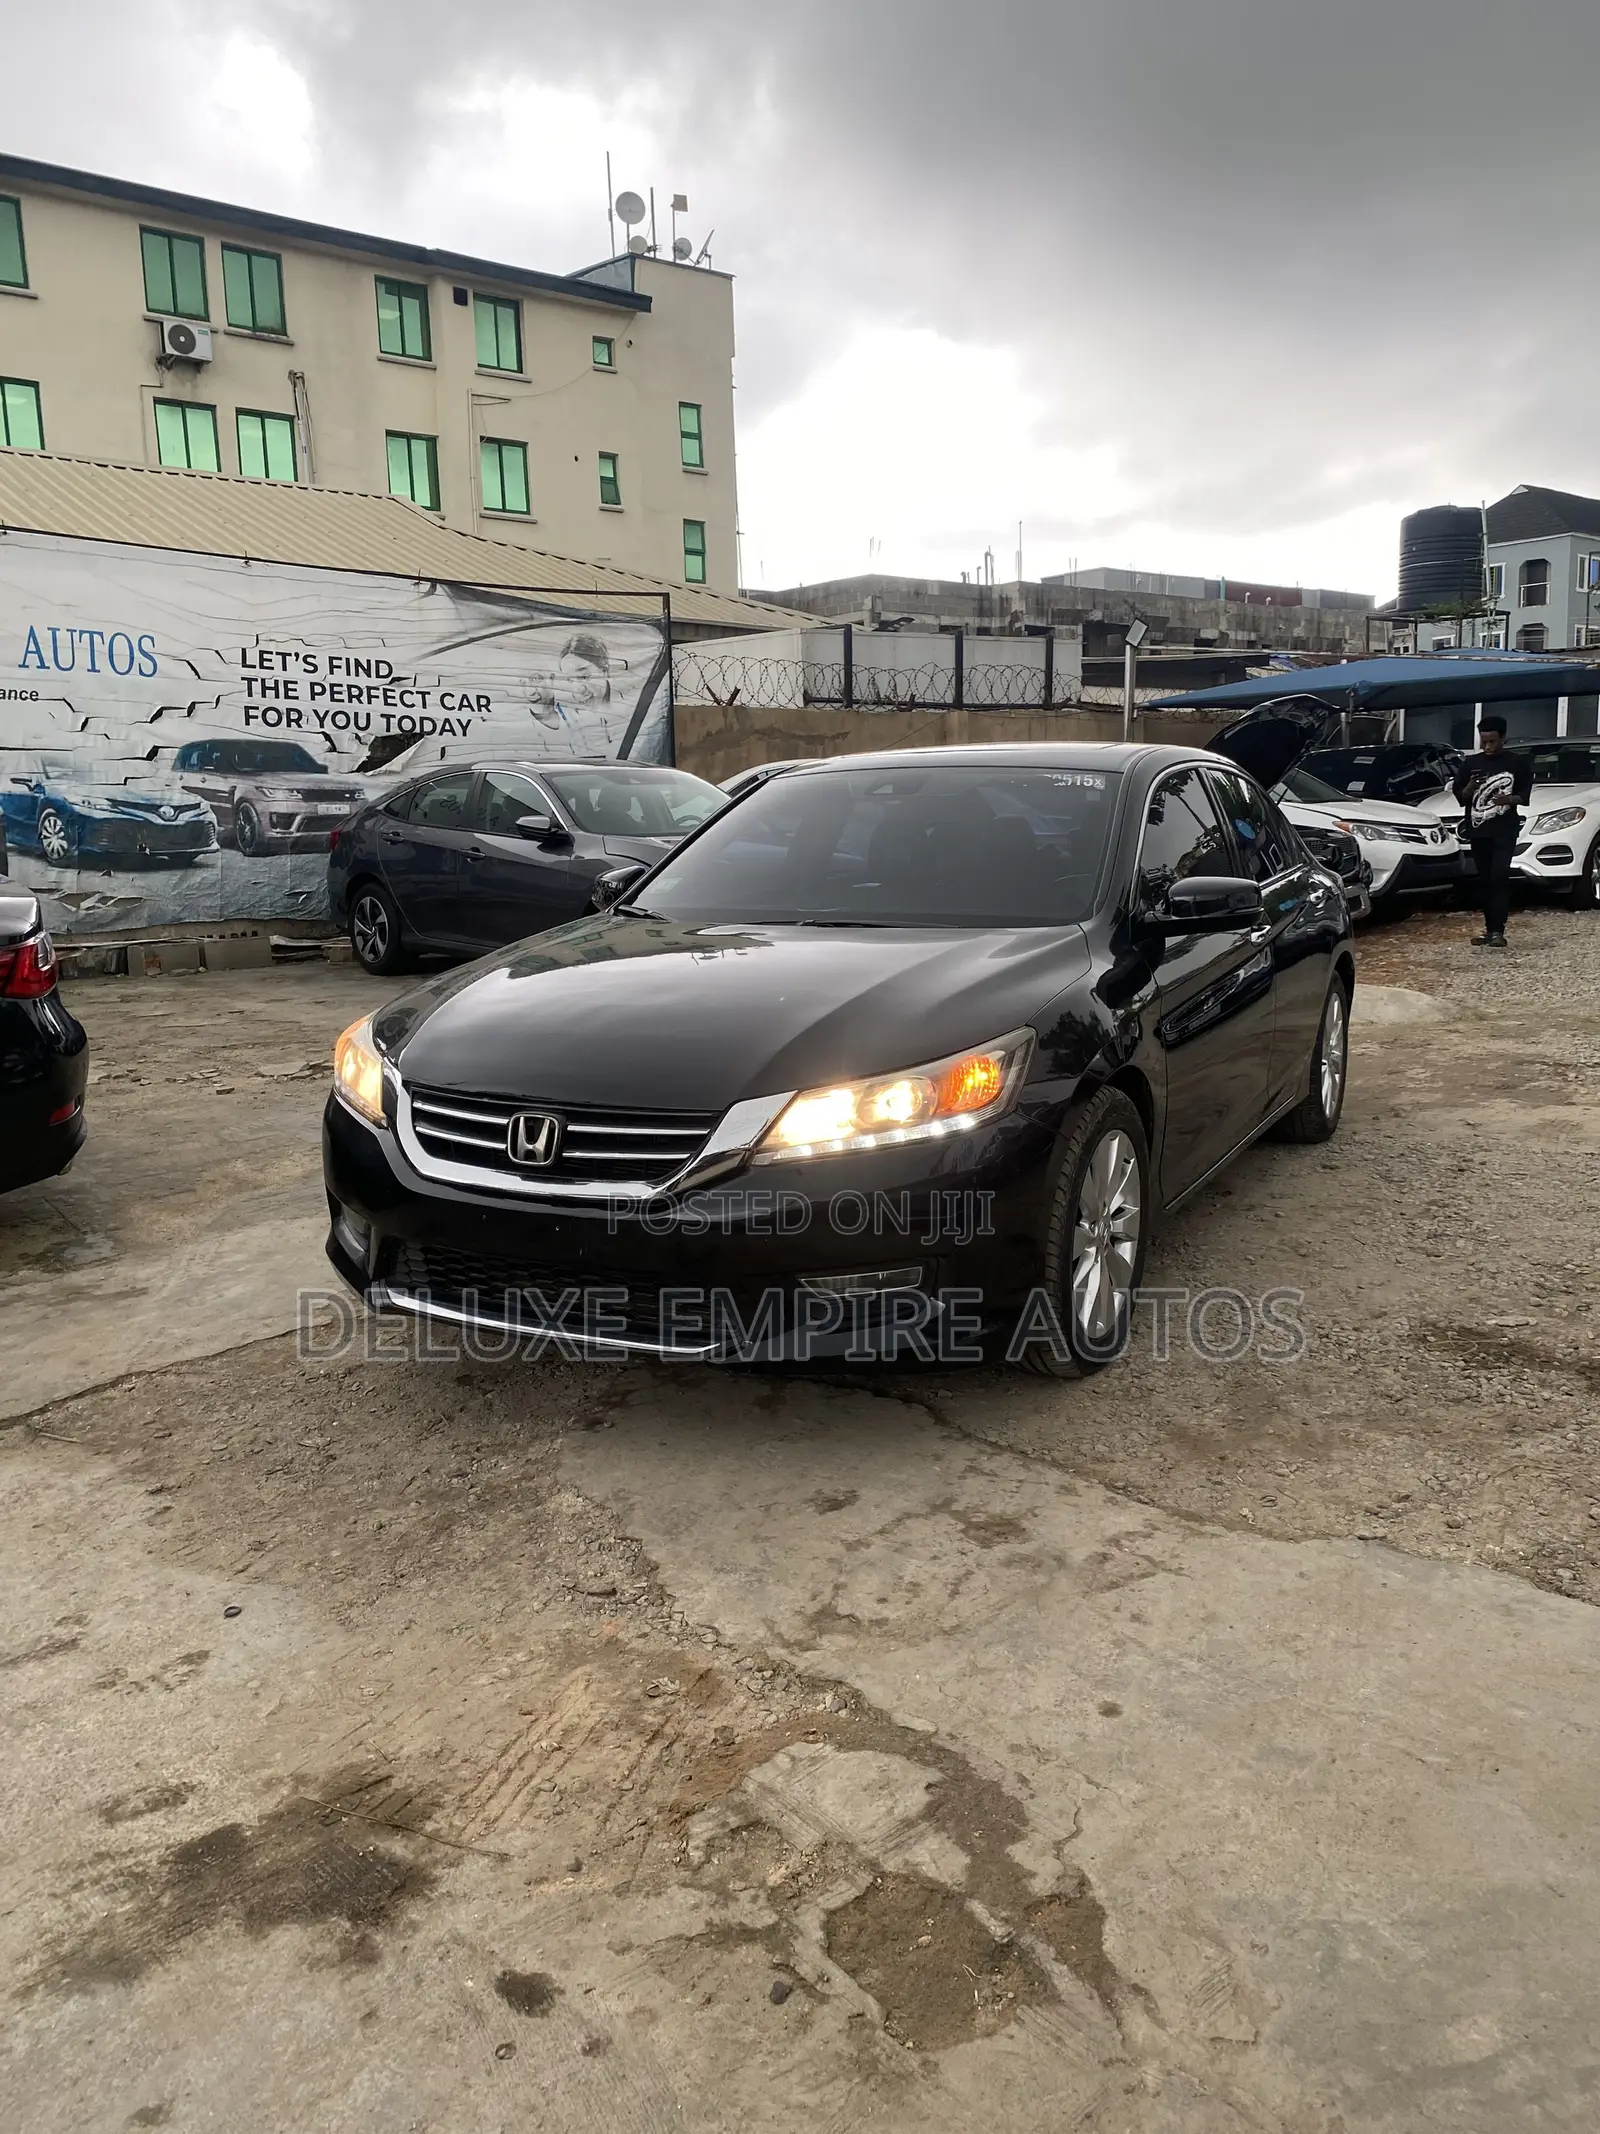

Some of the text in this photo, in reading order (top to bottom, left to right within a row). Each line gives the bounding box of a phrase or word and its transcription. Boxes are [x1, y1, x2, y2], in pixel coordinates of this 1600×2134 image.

[18, 625, 158, 678] AUTOS
[241, 648, 393, 679] LET'S FIND
[241, 677, 492, 713] THE PERFECT CAR
[244, 705, 472, 737] FOR YOU TODAY
